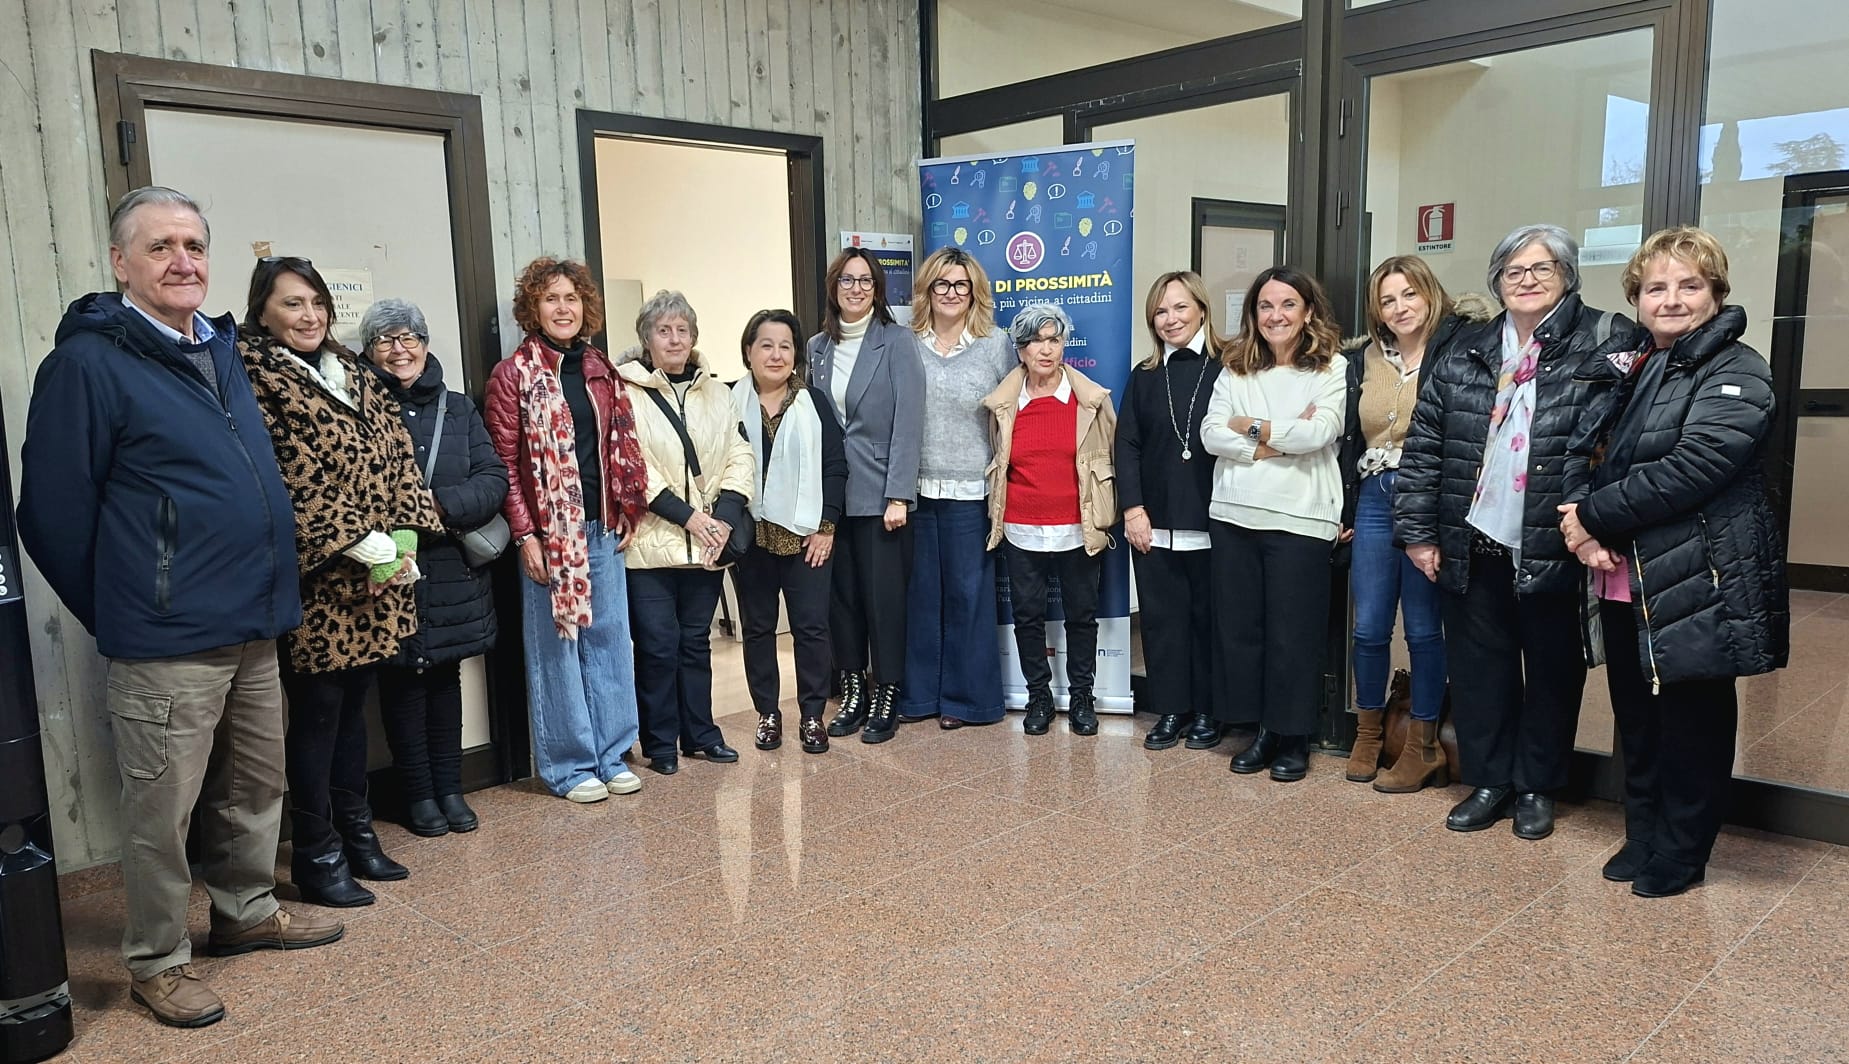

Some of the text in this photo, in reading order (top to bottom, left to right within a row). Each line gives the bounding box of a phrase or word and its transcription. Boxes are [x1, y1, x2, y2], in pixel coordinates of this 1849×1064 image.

[1418, 244, 1452, 252] ESTINTORE
[995, 280, 1011, 293] DI
[1015, 271, 1113, 292] PROSSIMITÀ
[1000, 296, 1016, 311] più
[1054, 294, 1064, 305] ai
[1066, 292, 1112, 304] cittadini
